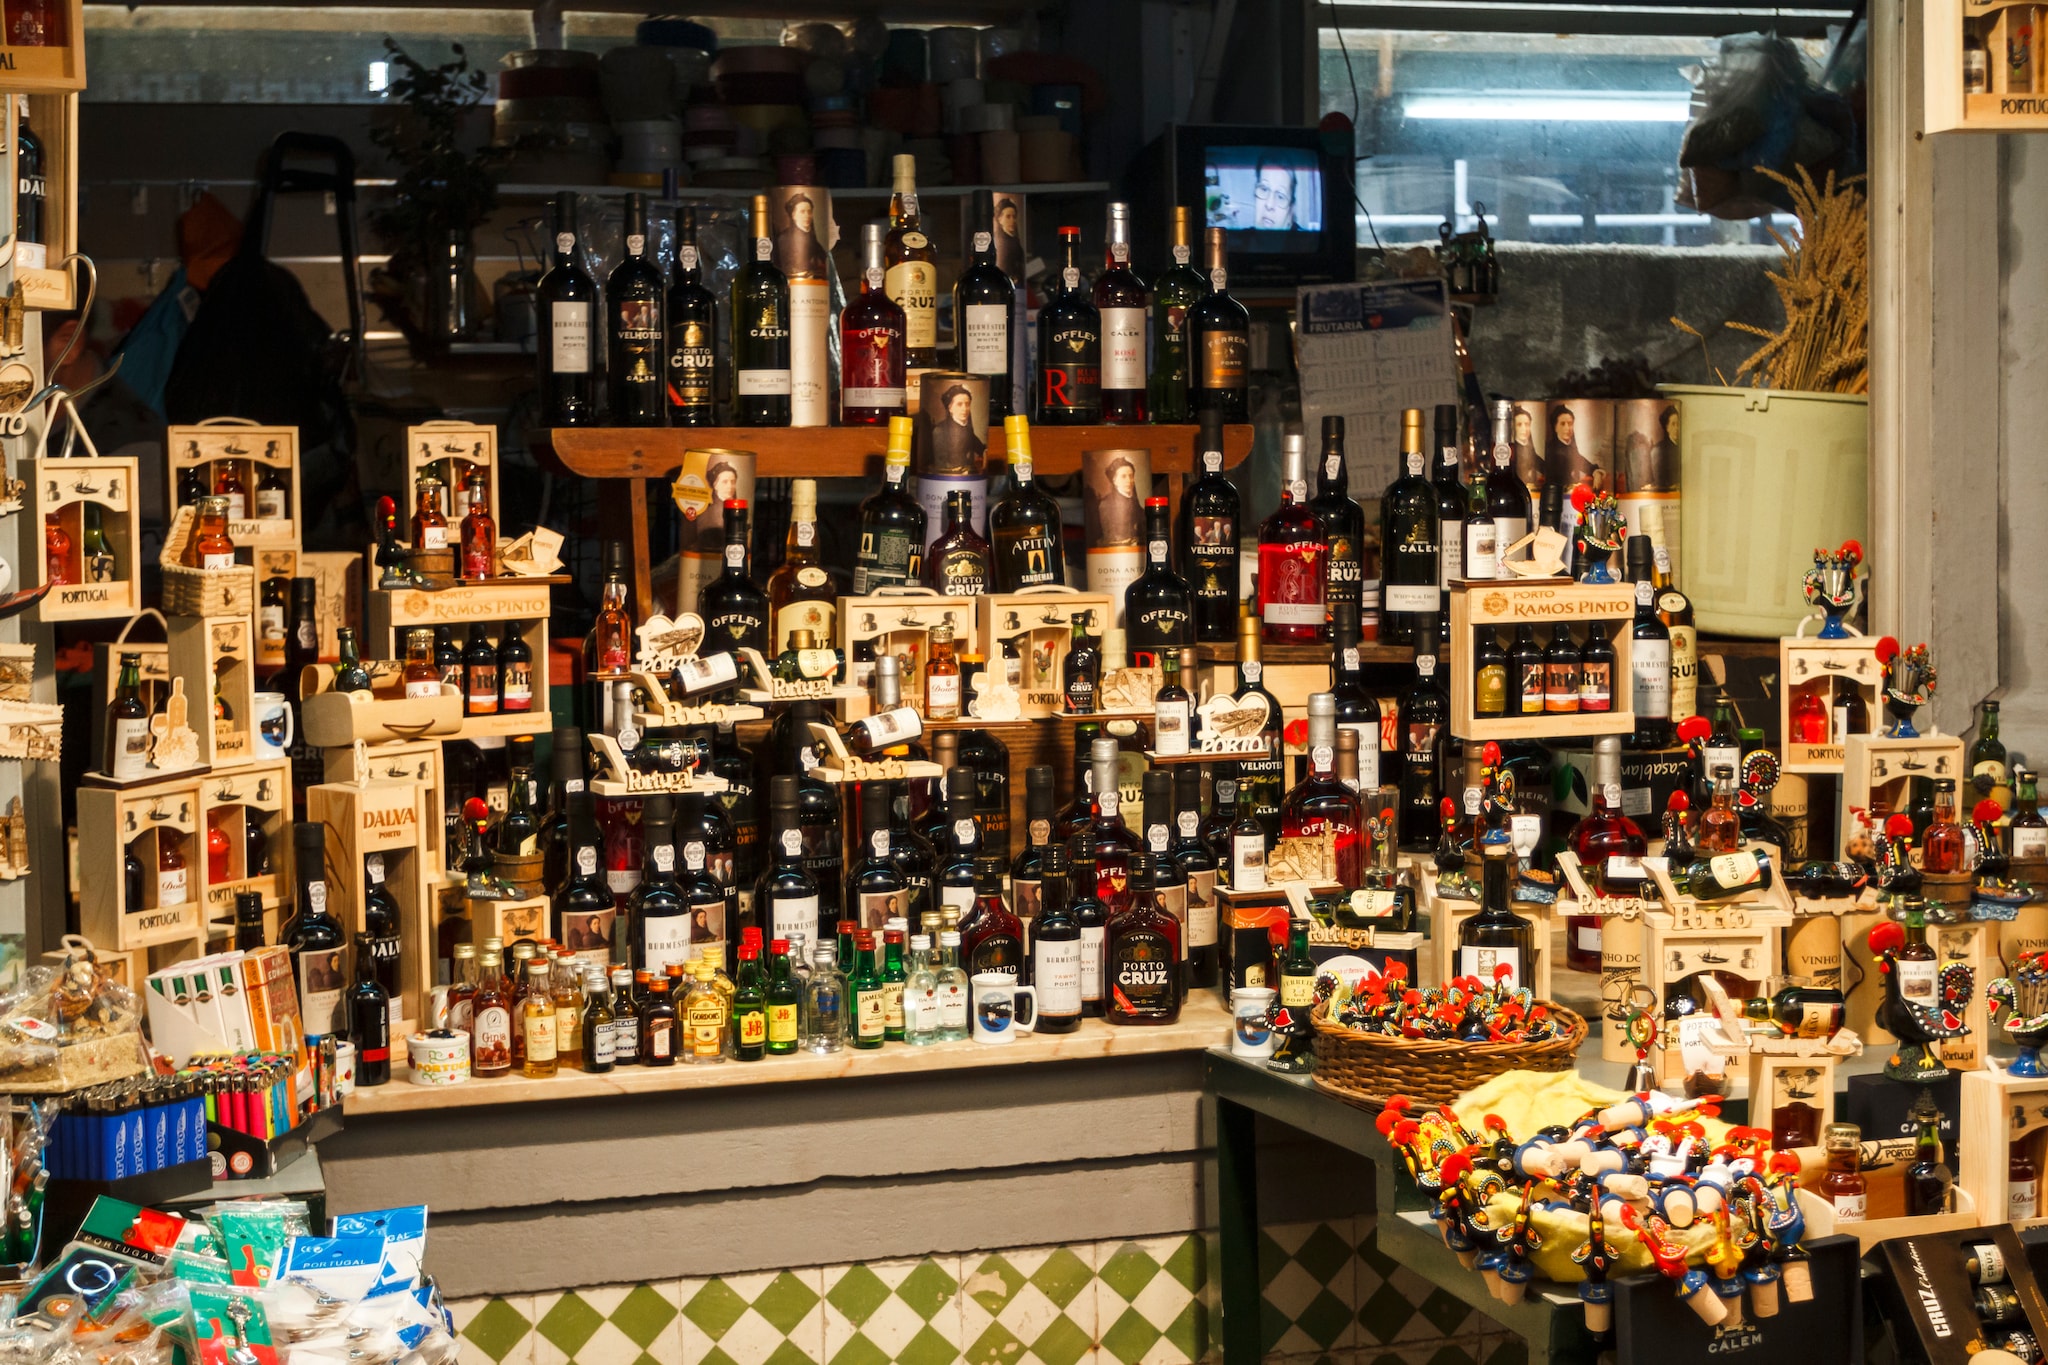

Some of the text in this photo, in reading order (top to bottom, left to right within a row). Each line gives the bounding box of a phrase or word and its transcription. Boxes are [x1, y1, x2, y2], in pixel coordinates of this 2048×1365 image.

[2001, 98, 2048, 114] PORTUG
[20, 179, 46, 196] DAL
[895, 296, 936, 309] CRUZ
[859, 326, 901, 340] OFFLEY
[1310, 321, 1363, 333] FRUTARIA
[618, 331, 662, 340] VELHOTES
[1053, 329, 1097, 343] OFFLEY
[671, 355, 714, 368] CRUZ
[1044, 369, 1073, 406] R
[229, 523, 261, 535] TUGAL
[1191, 546, 1235, 555] VELHOTES
[1285, 541, 1326, 553] OFFLEY
[948, 576, 982, 585] PORTO
[1021, 572, 1054, 583] SANDEMAN
[433, 590, 473, 600] PORTO
[945, 584, 985, 595] CRUZ
[1514, 590, 1555, 600] PORTO
[62, 590, 109, 603] PORTUGAL
[435, 600, 546, 618] RAMOS PINTO
[1514, 600, 1630, 617] RAMOS PINTO
[711, 614, 762, 628] OFFLEY
[1140, 610, 1189, 624] OFFLEY
[1670, 664, 1697, 679] RUZ
[772, 676, 834, 700] Portugal
[1070, 684, 1093, 692] CRUZ
[662, 700, 730, 727] Porto
[1200, 736, 1264, 753] PORTO
[1808, 748, 1845, 760] PORTUG
[842, 755, 908, 782] Porto
[1239, 761, 1283, 771] VELHOTES
[626, 765, 693, 793] Portugal
[363, 807, 417, 829] DALVA
[378, 830, 402, 839] PORTO
[139, 911, 180, 930] PORTUGAL
[1672, 903, 1752, 931] Porto
[1130, 934, 1154, 942] TAWNY
[1309, 921, 1376, 950] Portugal
[989, 938, 1010, 948] TAWNY
[981, 964, 1017, 975] PORTO
[1123, 961, 1165, 971] PORTO
[1118, 970, 1168, 985] CRUZ
[745, 1020, 763, 1037] J&B
[1942, 1050, 1974, 1062] Portugal
[417, 1060, 471, 1073] PORTUGA
[1885, 1148, 1916, 1159] PORTO
[84, 1234, 158, 1264] PORTUGAL
[303, 1259, 366, 1270] PORTUGAL
[1985, 1251, 1996, 1278] CRUZ
[1907, 1241, 1952, 1338] CRUZ Collection
[1707, 1332, 1763, 1354] CALEM
